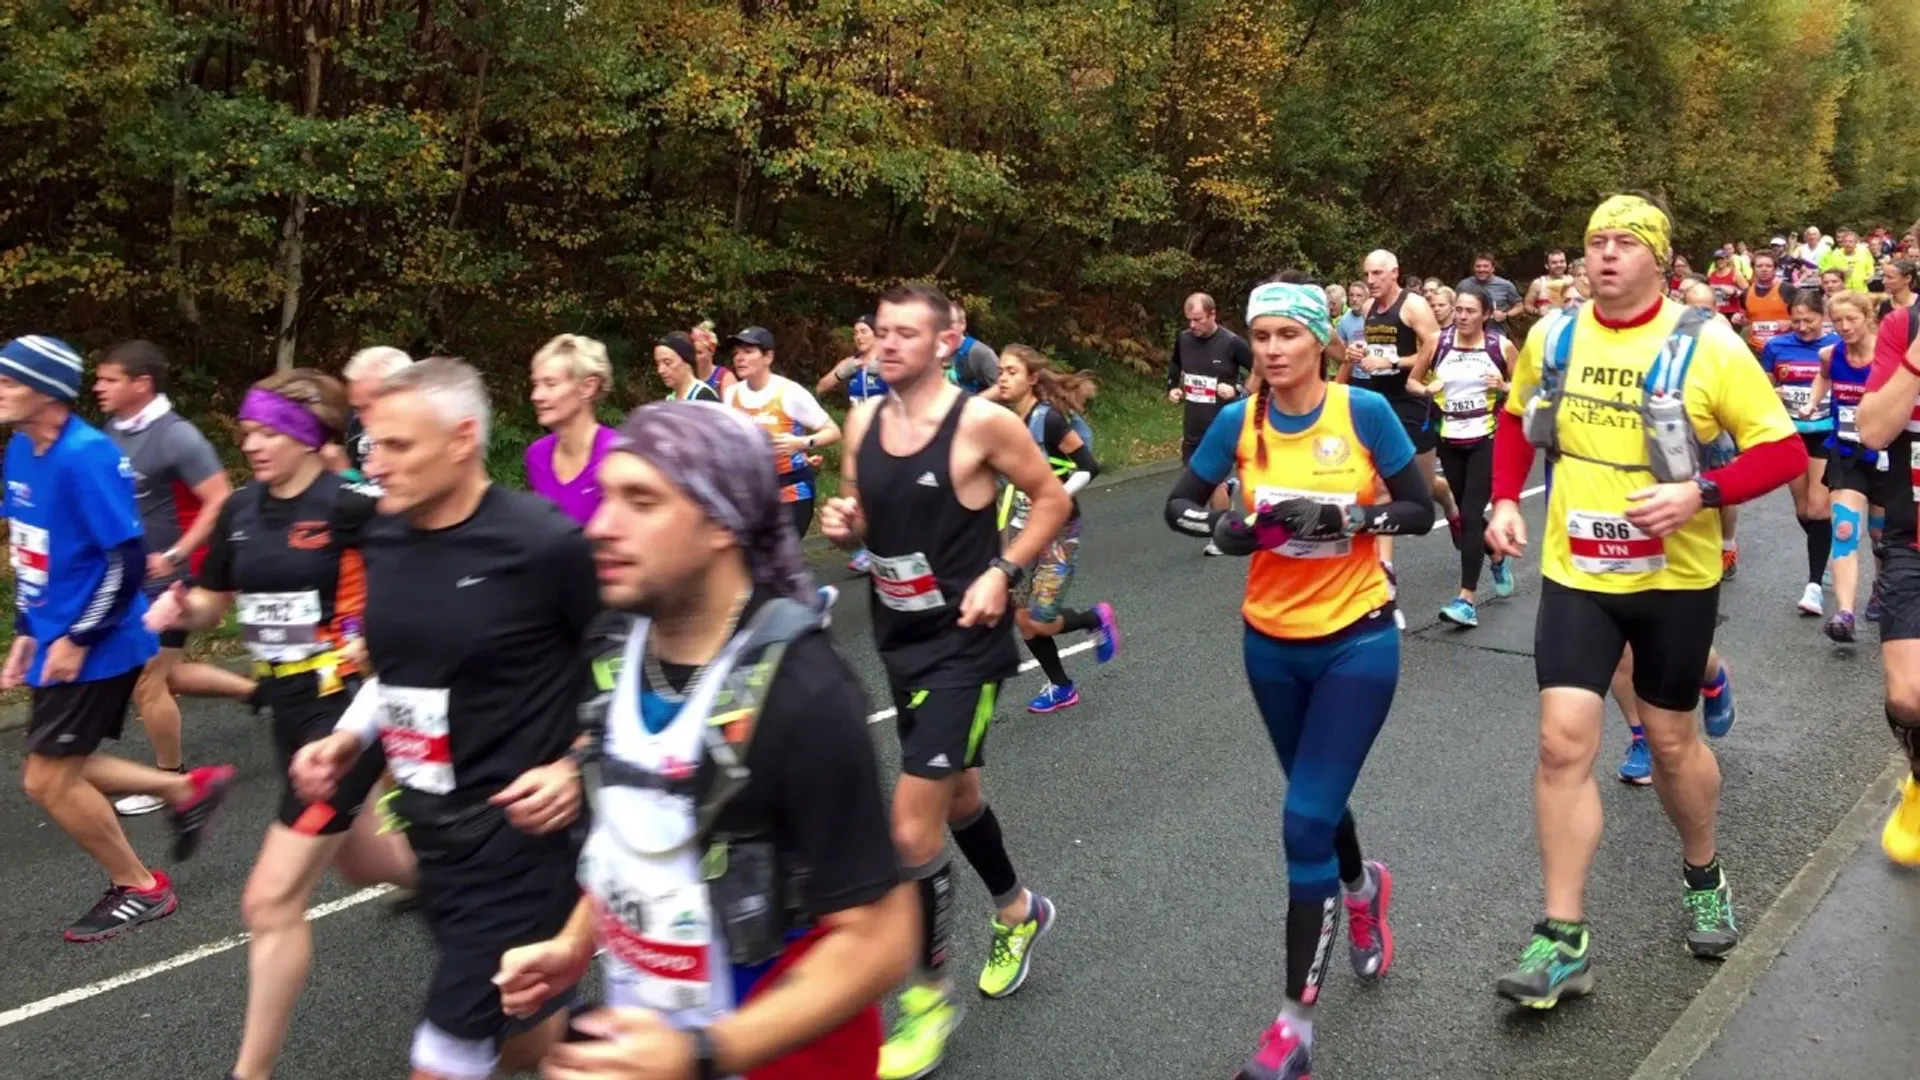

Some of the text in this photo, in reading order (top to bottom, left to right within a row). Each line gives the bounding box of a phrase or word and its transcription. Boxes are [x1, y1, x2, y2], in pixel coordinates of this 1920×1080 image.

[1452, 400, 1475, 411] 2621
[1592, 521, 1630, 540] 636
[1598, 544, 1629, 556] LYN
